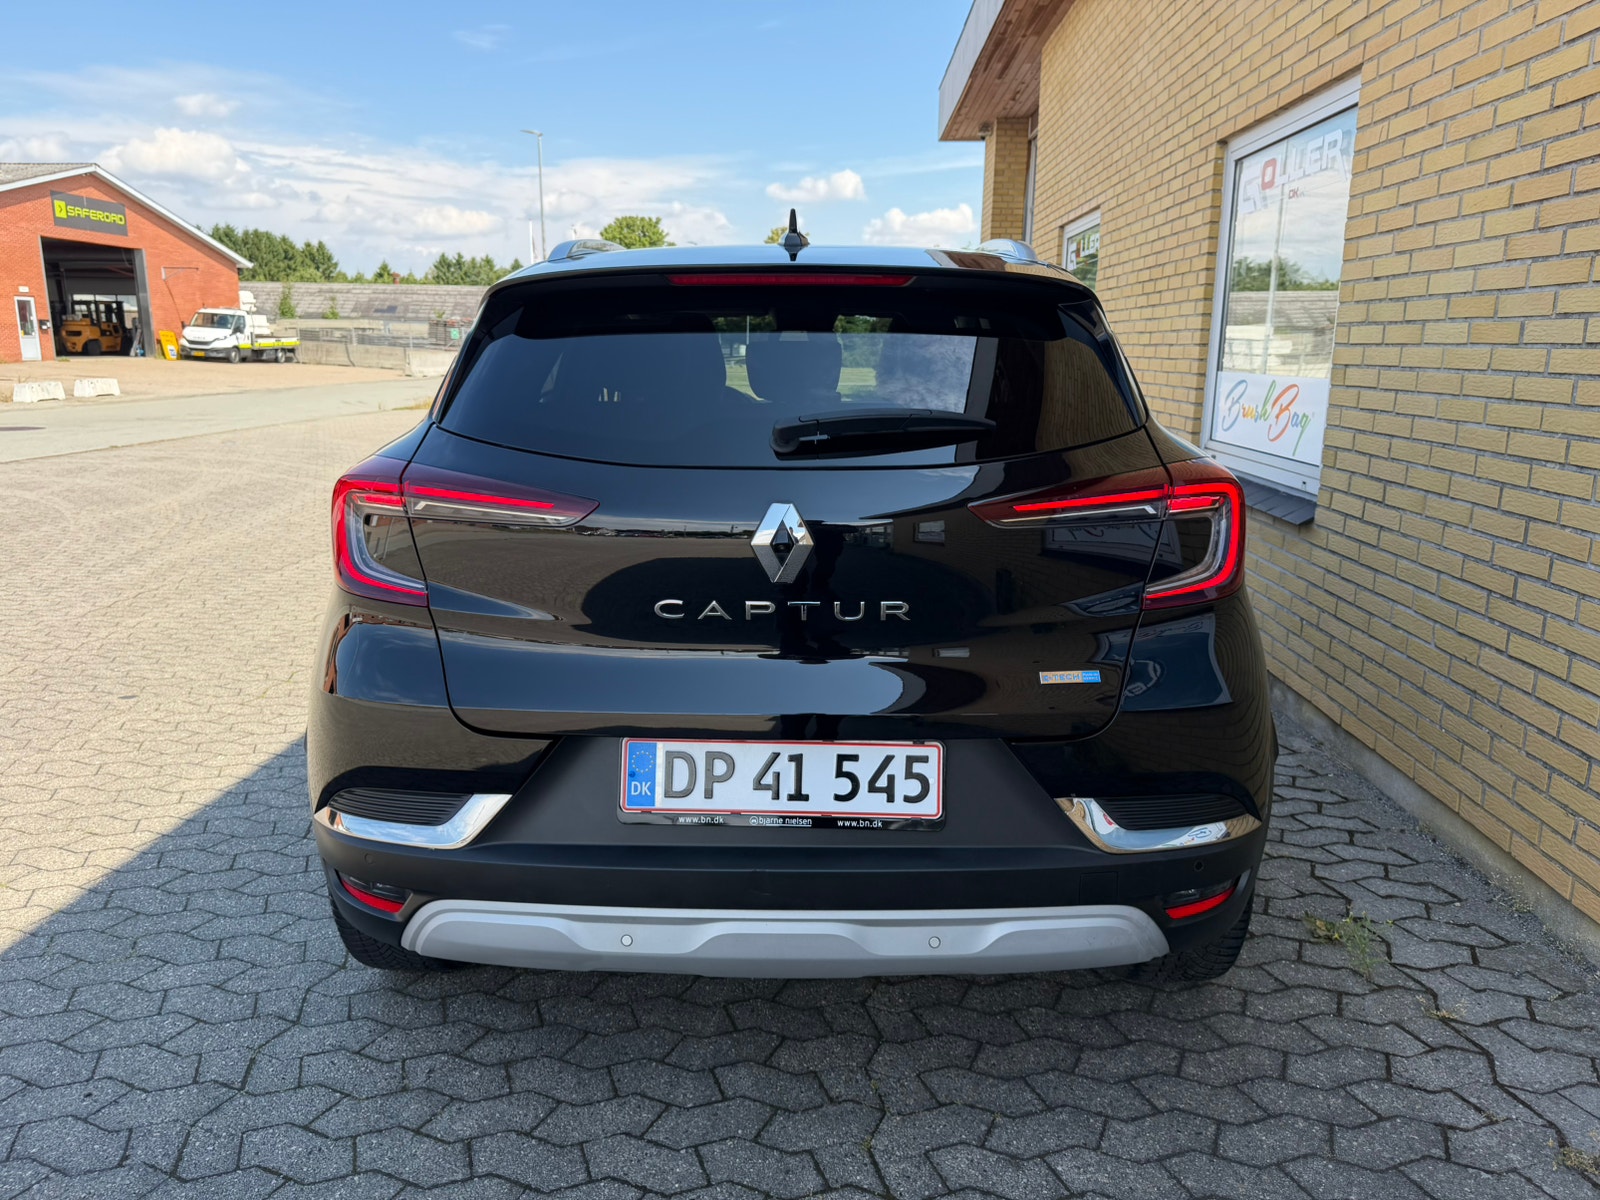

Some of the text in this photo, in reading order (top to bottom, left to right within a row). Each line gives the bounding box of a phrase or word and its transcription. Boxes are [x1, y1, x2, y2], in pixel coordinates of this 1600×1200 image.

[67, 205, 125, 225] SAFEROAD
[654, 599, 911, 621] CAPTUR
[664, 750, 930, 803] DP 41 545
[631, 781, 651, 796] DK
[678, 815, 724, 824] www.bn.dk
[759, 816, 812, 826] bjarne nielsen
[837, 819, 883, 828] www.bn.dk
